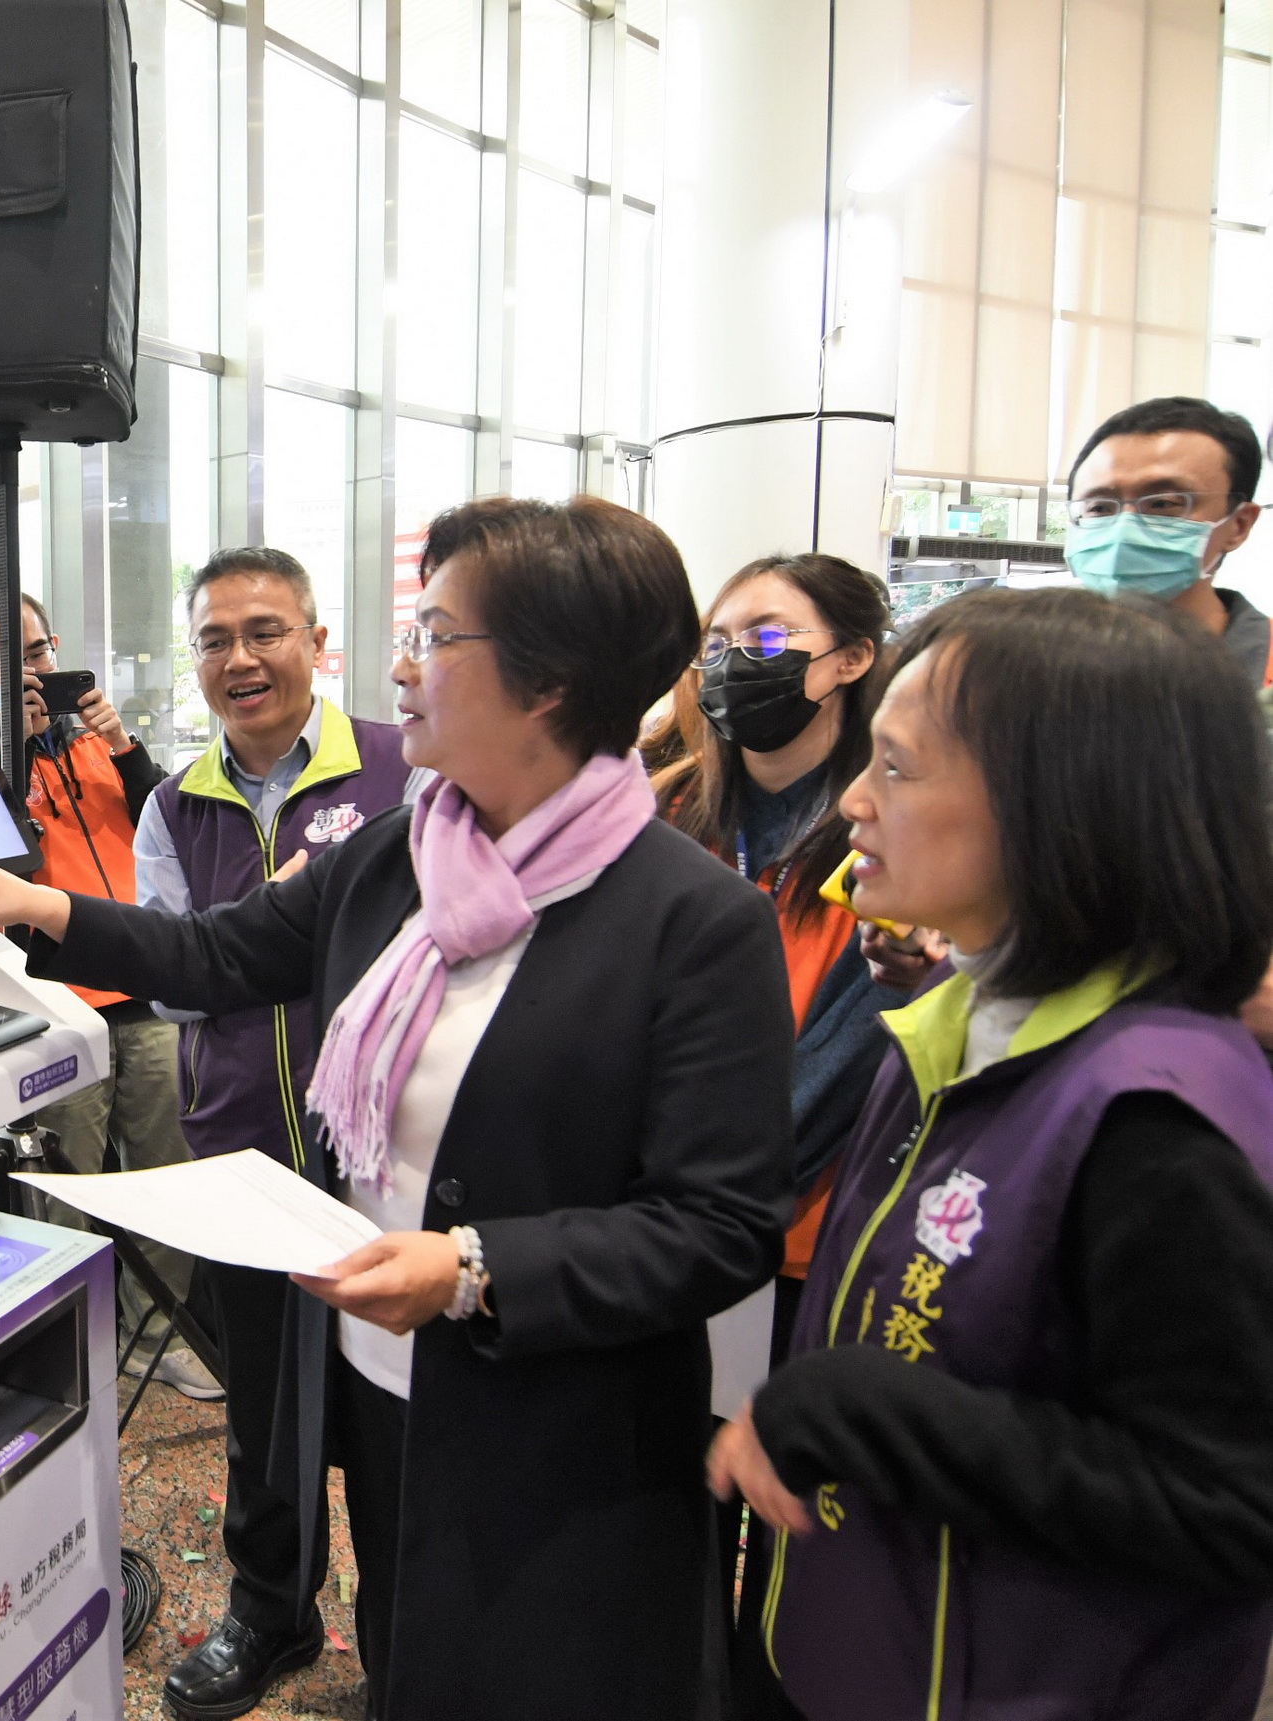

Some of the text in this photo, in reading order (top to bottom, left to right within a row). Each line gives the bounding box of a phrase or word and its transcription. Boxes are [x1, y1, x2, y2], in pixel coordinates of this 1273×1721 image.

[13, 1578, 58, 1626] Changhua
[59, 1548, 86, 1580] County
[20, 1518, 86, 1598] 地方稅務局
